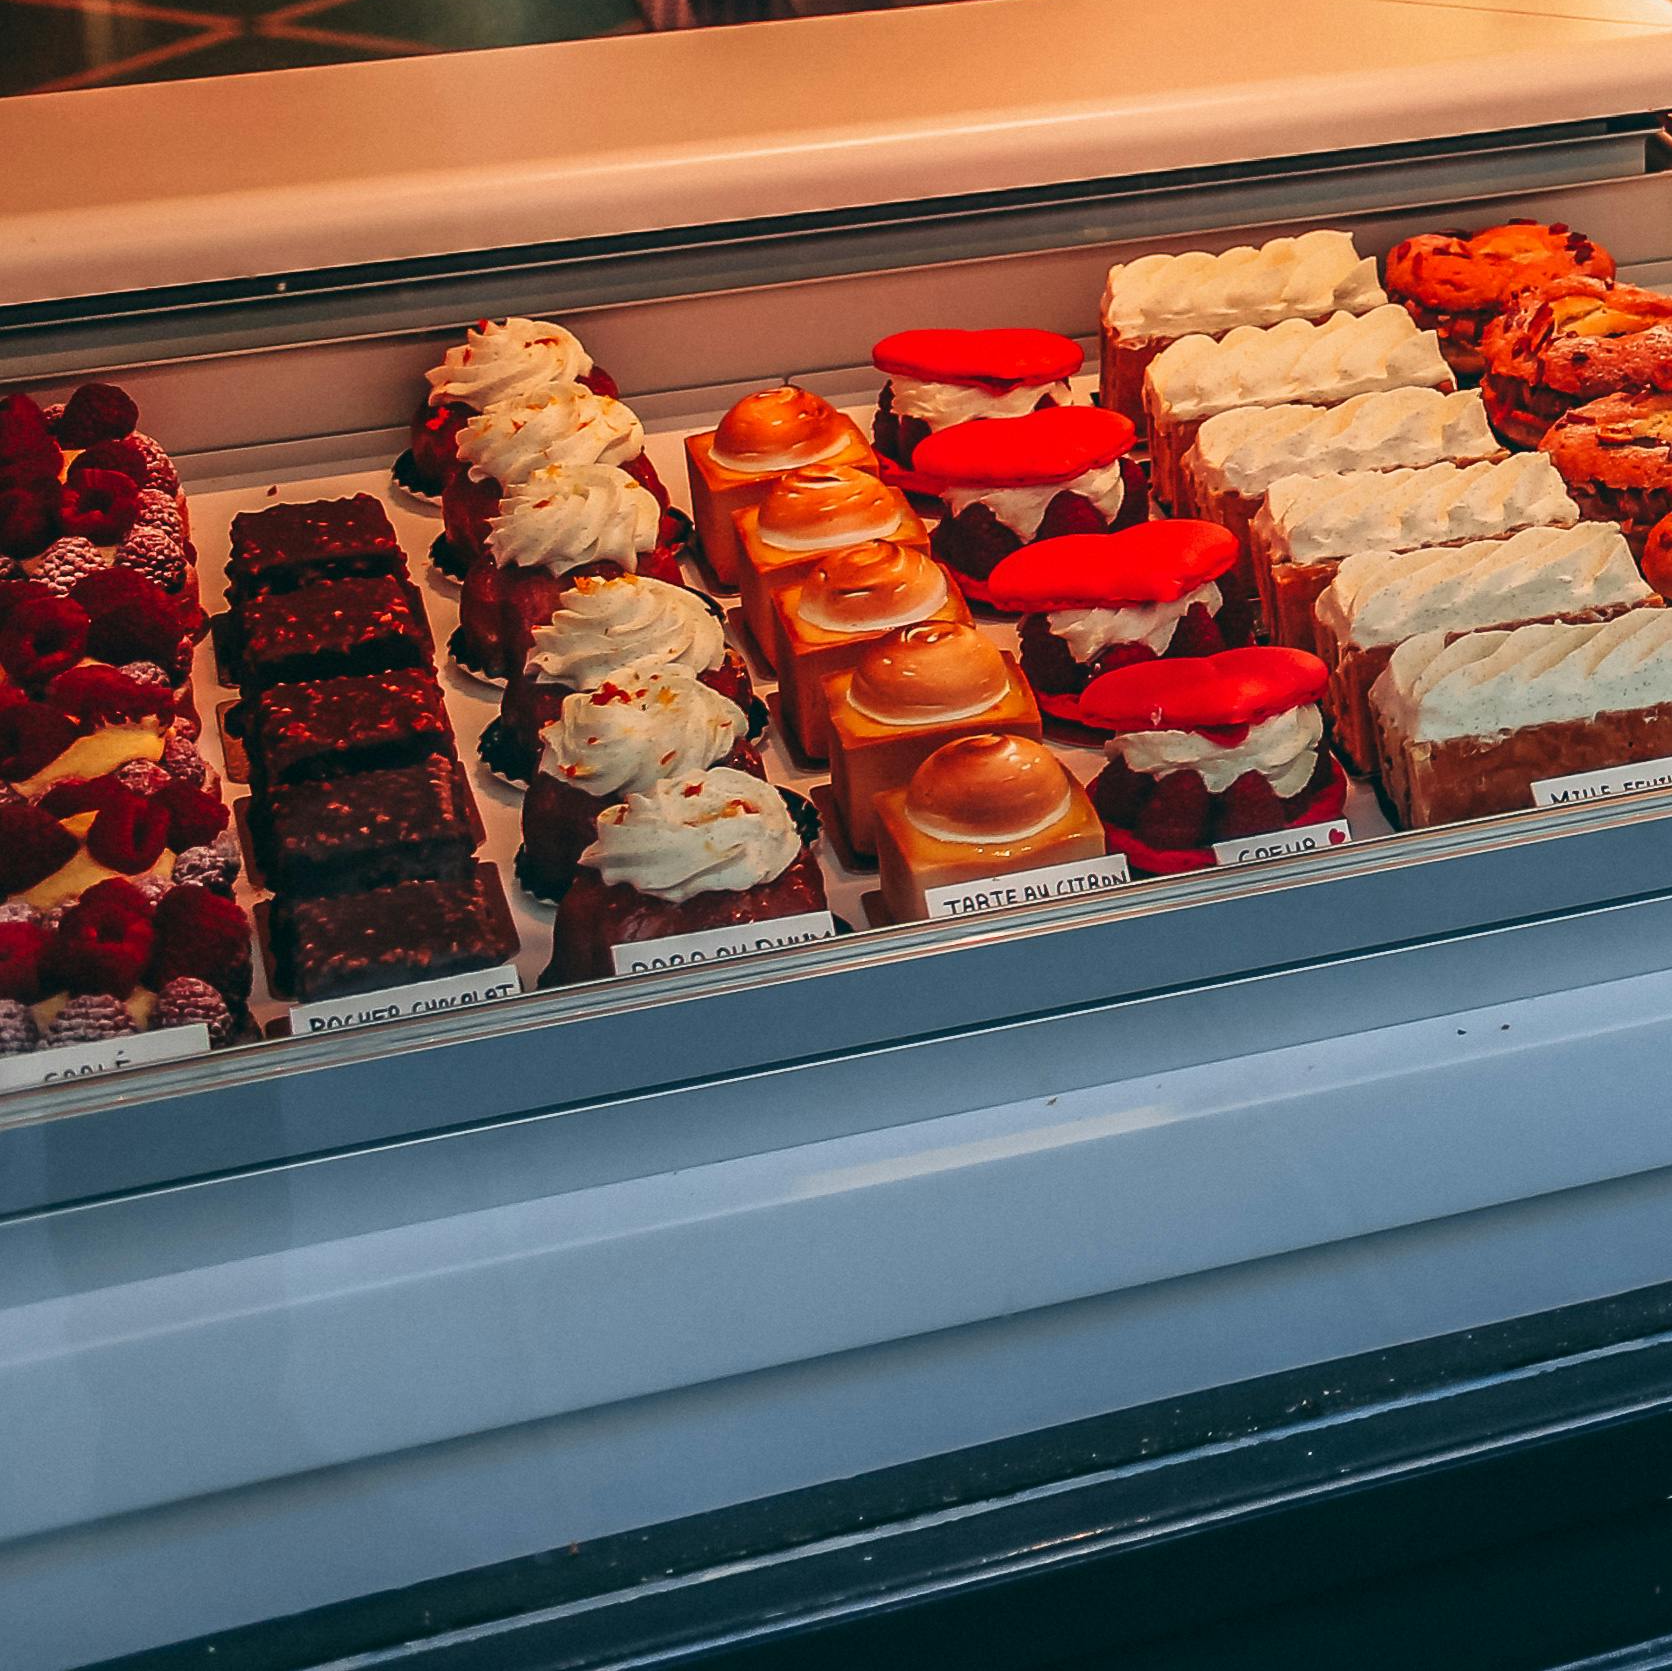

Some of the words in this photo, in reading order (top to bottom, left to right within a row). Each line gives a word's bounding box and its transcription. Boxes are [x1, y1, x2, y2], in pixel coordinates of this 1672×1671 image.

[943, 887, 1017, 916] TARTE
[1024, 883, 1050, 902] AU
[1055, 870, 1126, 896] CITRON
